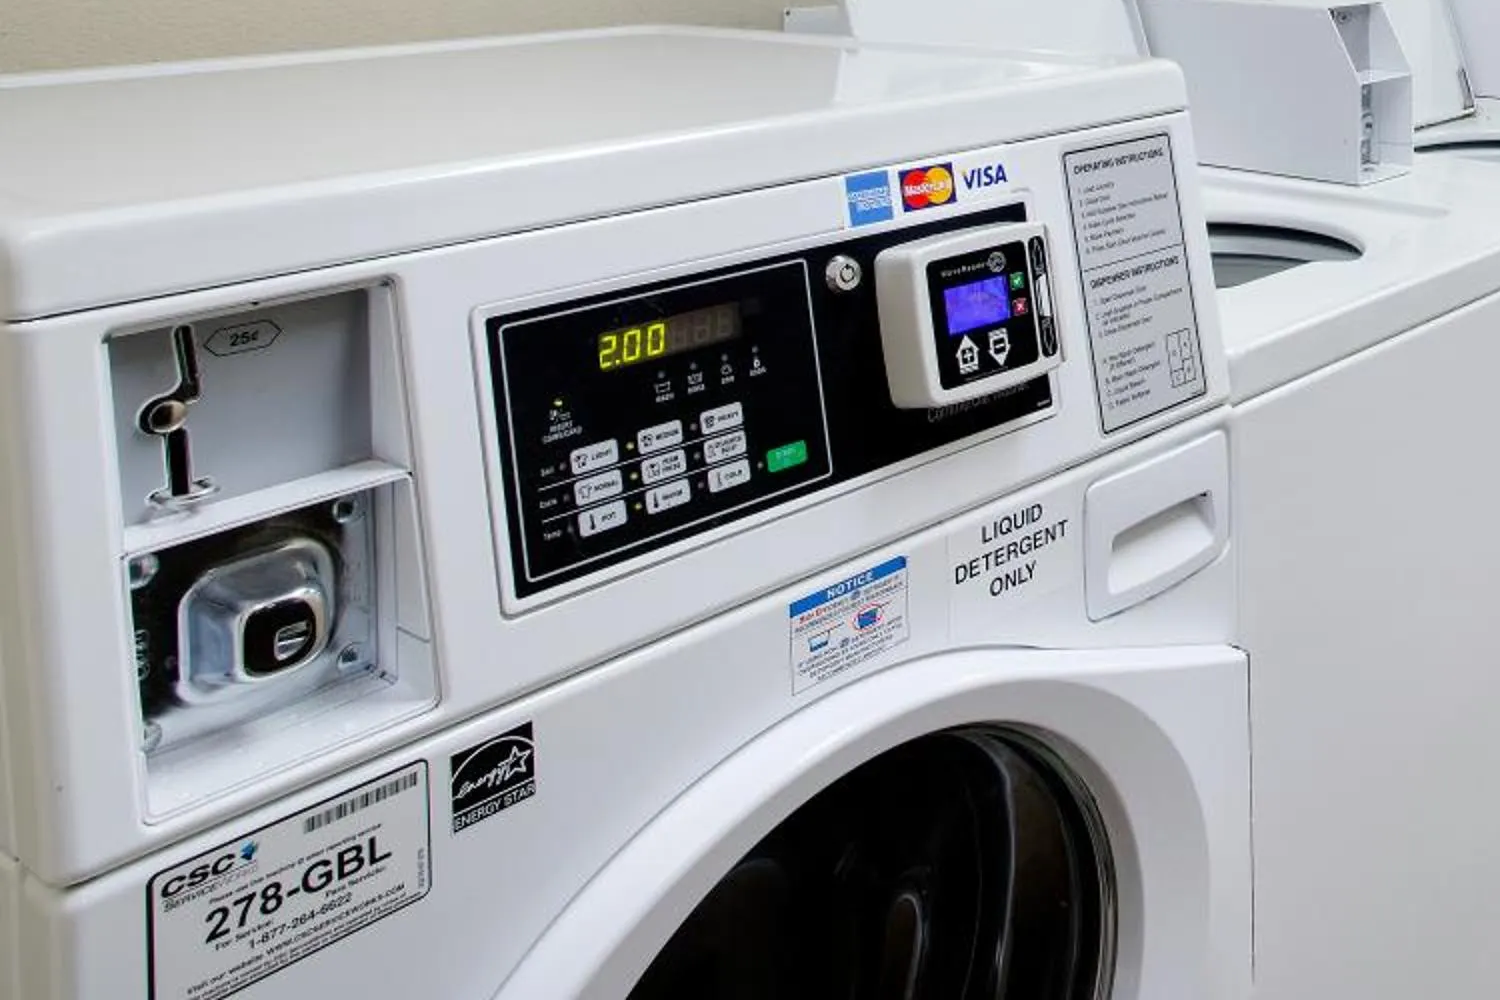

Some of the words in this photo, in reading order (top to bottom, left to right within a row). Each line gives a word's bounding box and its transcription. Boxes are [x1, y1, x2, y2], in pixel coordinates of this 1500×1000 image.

[963, 163, 1008, 190] VISA
[1115, 147, 1164, 166] INSTRUCTIONS
[598, 322, 667, 371] 2.00
[981, 503, 1043, 544] LIQUID
[954, 519, 1069, 585] DETERGENT
[826, 571, 874, 600] NOTICE
[989, 560, 1037, 597] ONLY
[454, 797, 502, 831] ENERGY
[503, 783, 537, 807] STAR
[161, 853, 236, 898] CSC
[205, 836, 393, 945] 278-GBL
